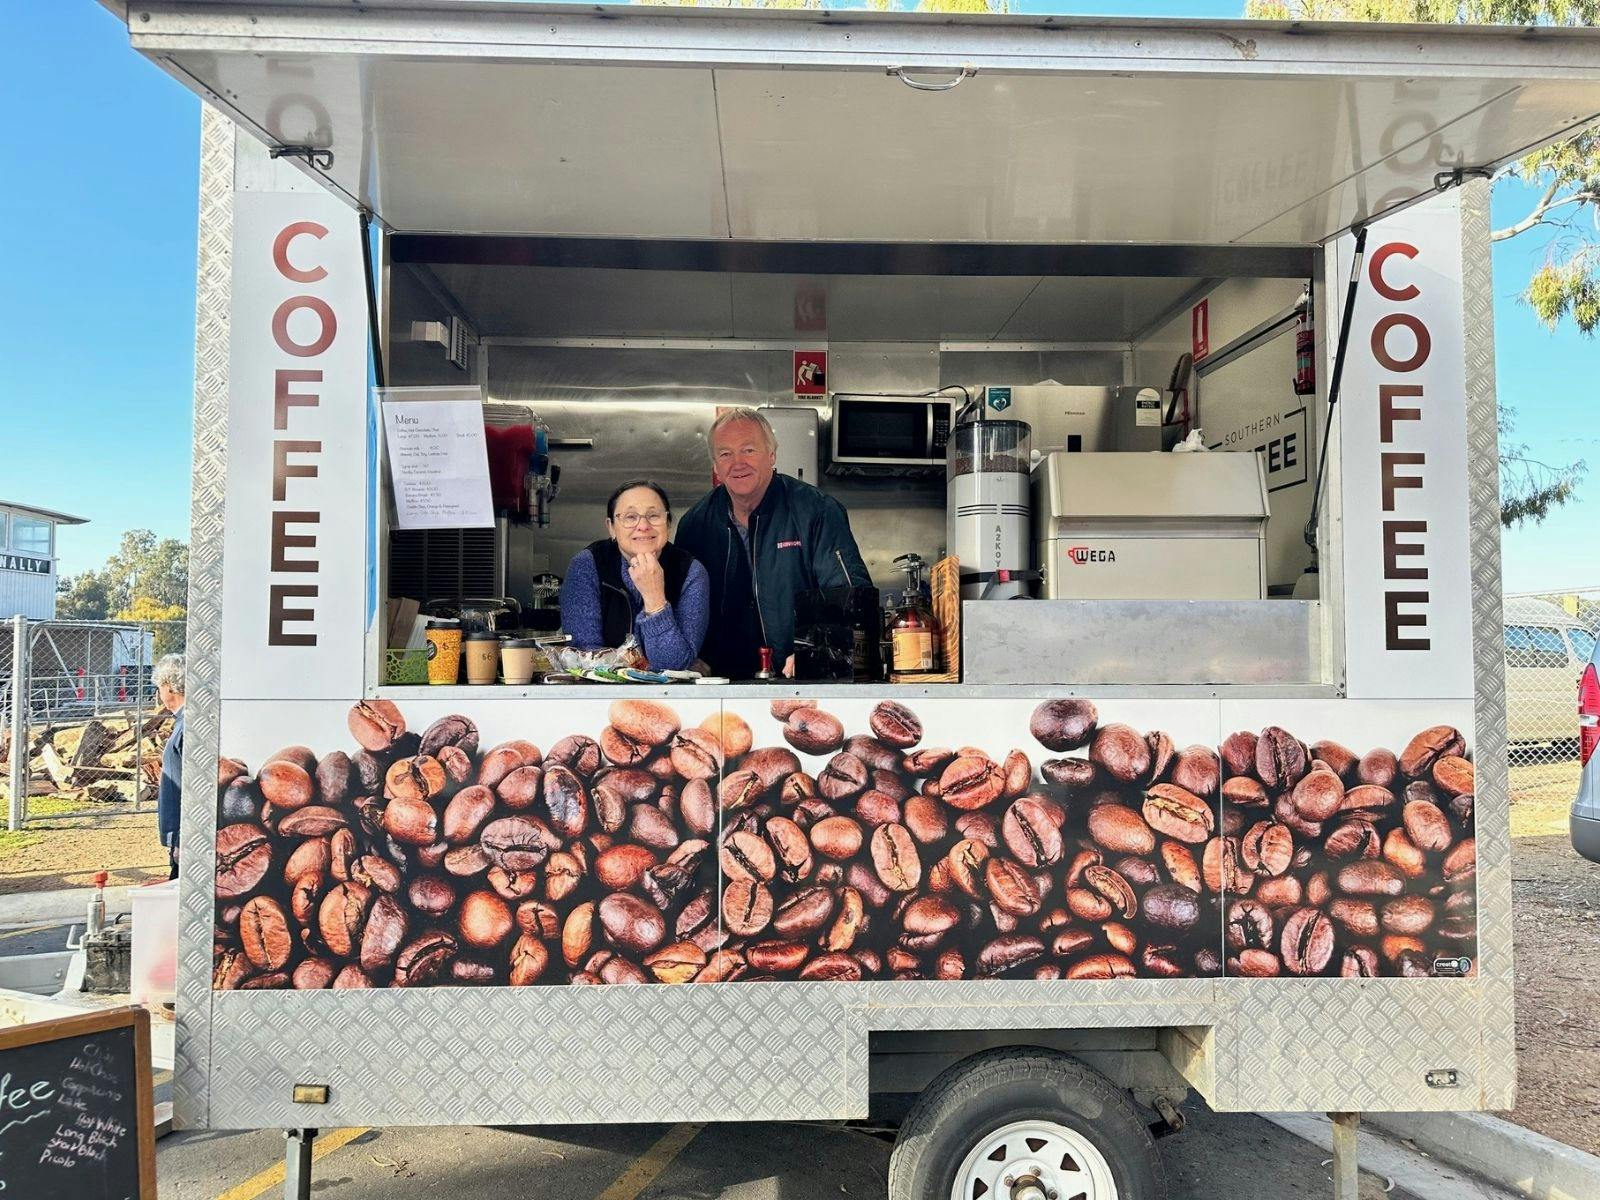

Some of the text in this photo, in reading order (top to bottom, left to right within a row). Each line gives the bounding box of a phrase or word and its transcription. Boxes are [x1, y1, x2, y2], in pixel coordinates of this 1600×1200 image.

[268, 221, 338, 647] COFFEE
[395, 414, 419, 425] Menu
[1224, 412, 1281, 446] SOUTHERN
[1368, 241, 1432, 651] COFFEE
[1076, 550, 1116, 562] WEGA
[56, 1124, 85, 1148] Long
